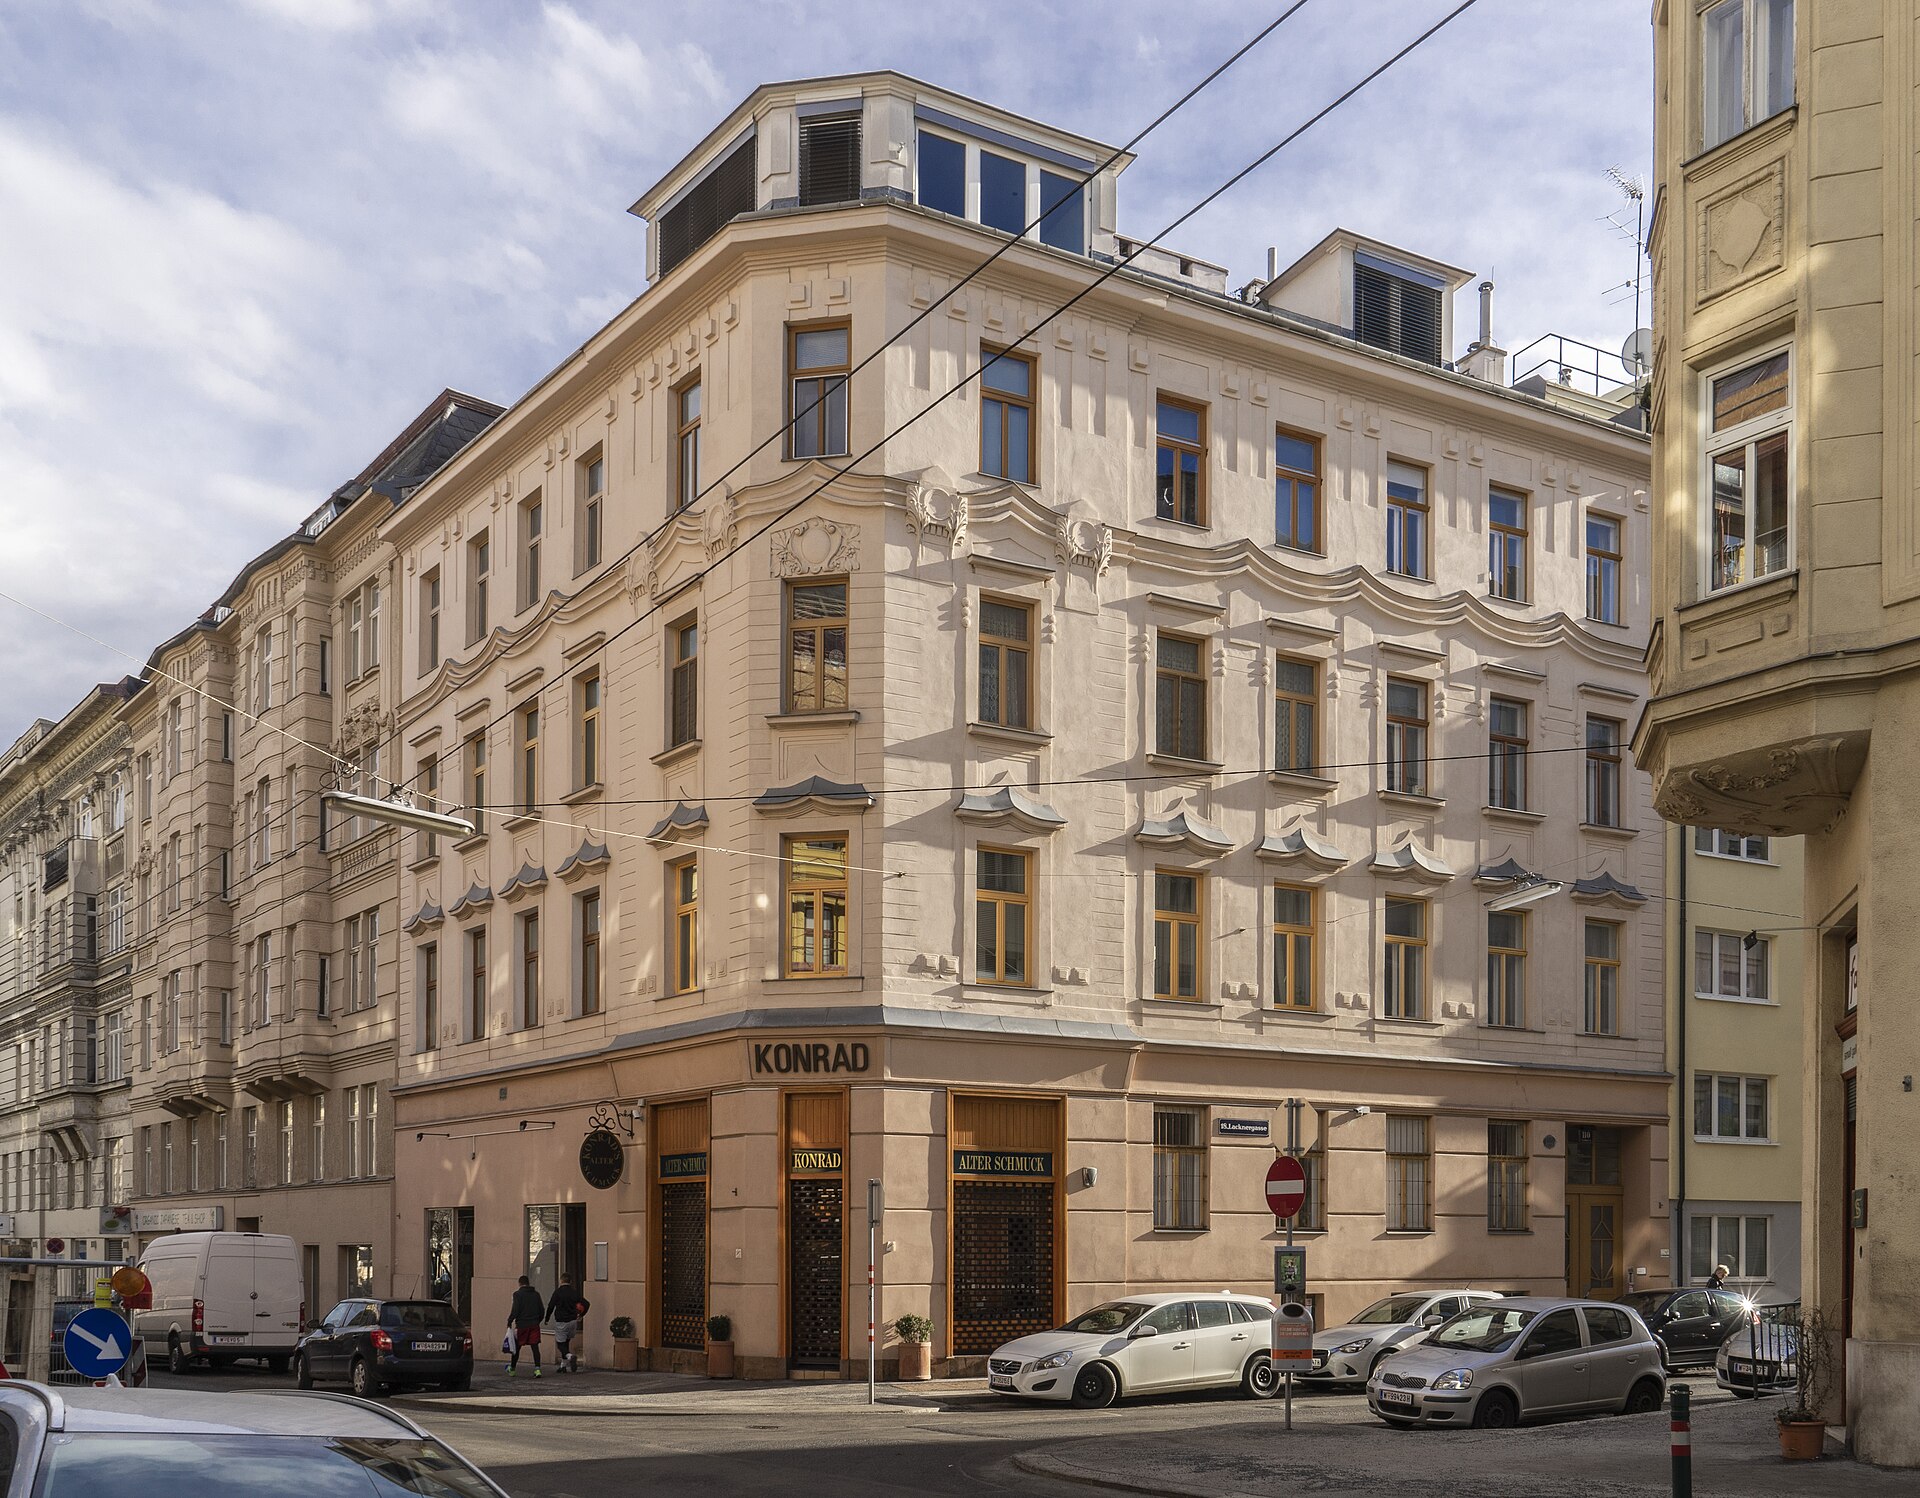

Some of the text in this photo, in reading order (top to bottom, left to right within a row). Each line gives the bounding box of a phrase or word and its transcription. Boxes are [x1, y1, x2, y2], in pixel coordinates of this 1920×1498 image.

[754, 1043, 869, 1074] KONRAD
[591, 1157, 614, 1165] ALTER
[663, 1156, 706, 1173] ALTER SCHMUC
[793, 1152, 841, 1169] KONRAD
[958, 1154, 1045, 1172] ALTER SCHMUCK
[584, 1164, 620, 1187] SCHMUCK
